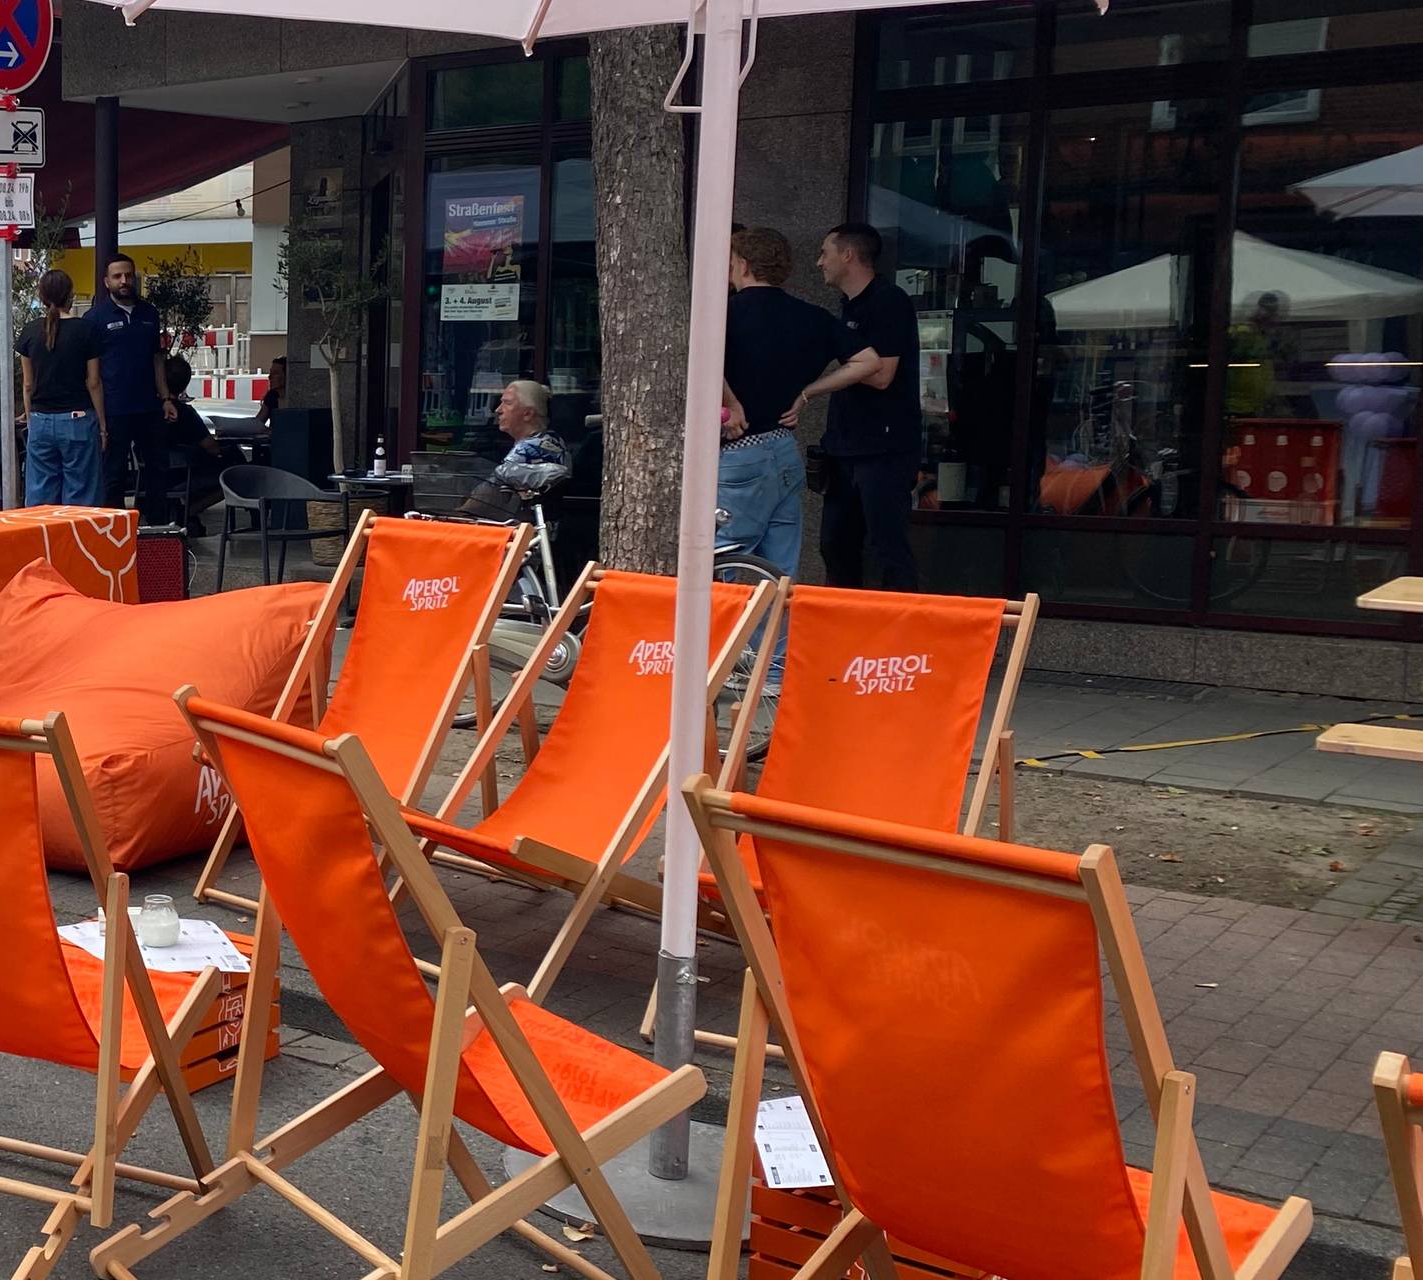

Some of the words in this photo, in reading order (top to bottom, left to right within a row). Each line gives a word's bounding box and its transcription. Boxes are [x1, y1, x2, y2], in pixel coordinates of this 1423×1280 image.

[467, 297, 492, 305] August
[402, 576, 460, 601] APEROL
[628, 640, 675, 664] APER
[843, 654, 932, 683] APEROL
